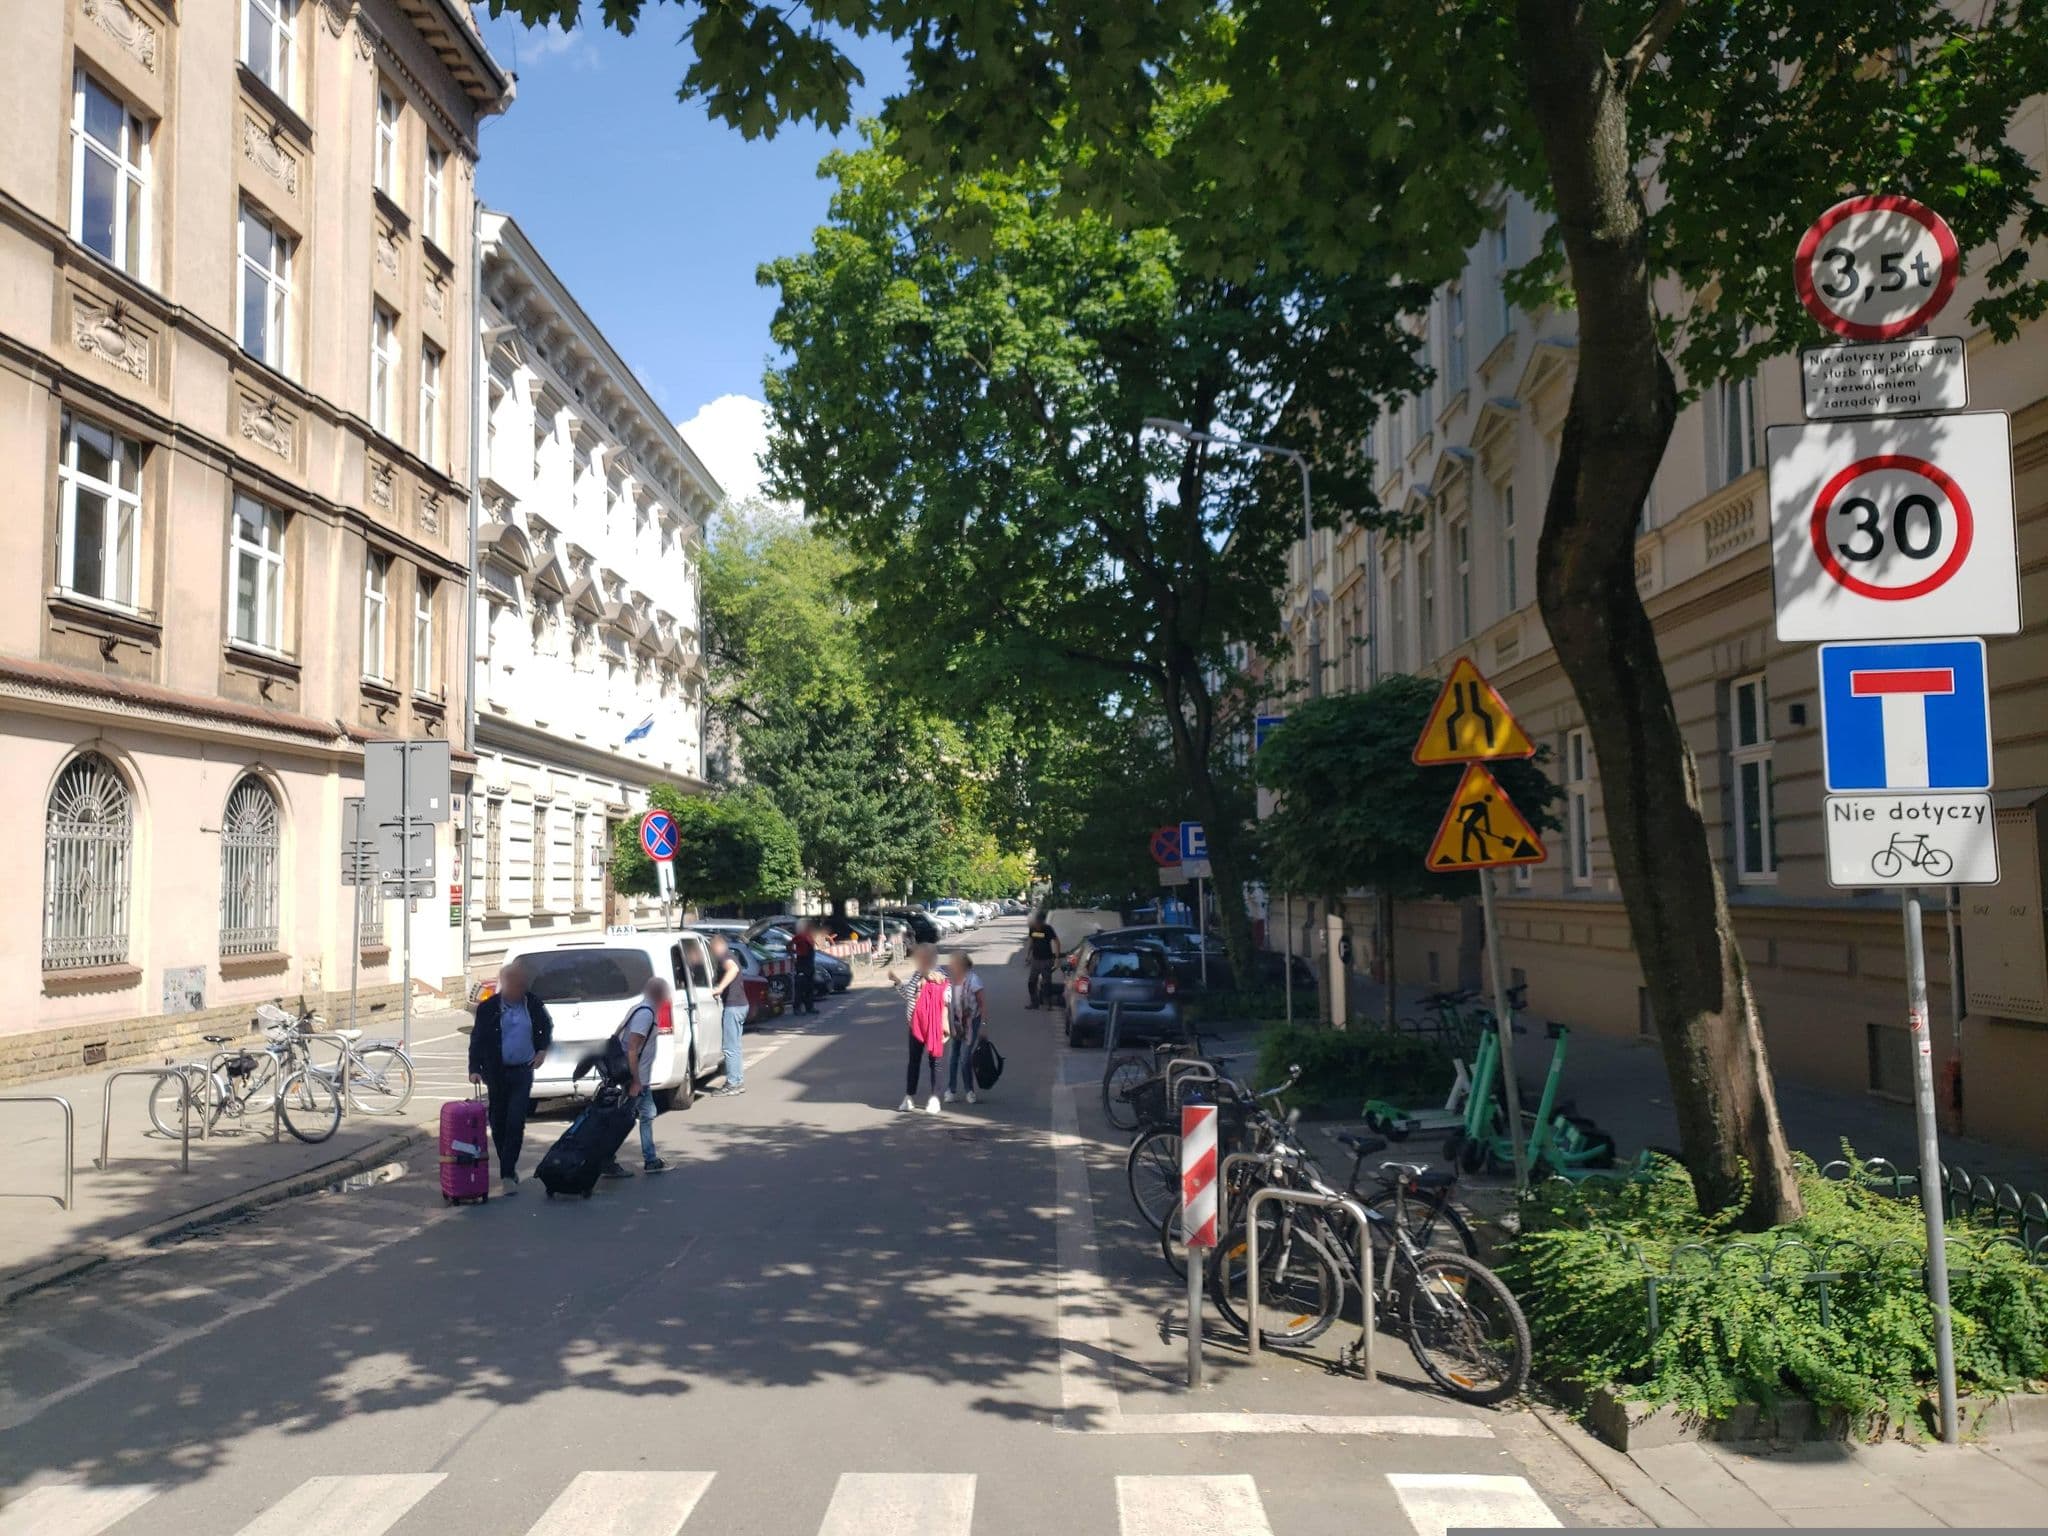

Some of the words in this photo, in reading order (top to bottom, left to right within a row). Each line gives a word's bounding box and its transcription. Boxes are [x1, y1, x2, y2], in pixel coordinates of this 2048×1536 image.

[1822, 248, 1931, 303] 3,5t
[1810, 354, 1832, 366] Nie
[1837, 350, 1885, 364] dotyczy
[1862, 362, 1923, 377] miejskich
[1834, 378, 1916, 394] zezwoleniem
[1887, 392, 1921, 404] drogi
[1838, 494, 1942, 561] 30
[1834, 803, 1875, 822] Nie
[1889, 801, 1985, 825] dotyczy
[610, 925, 634, 935] TAXI
